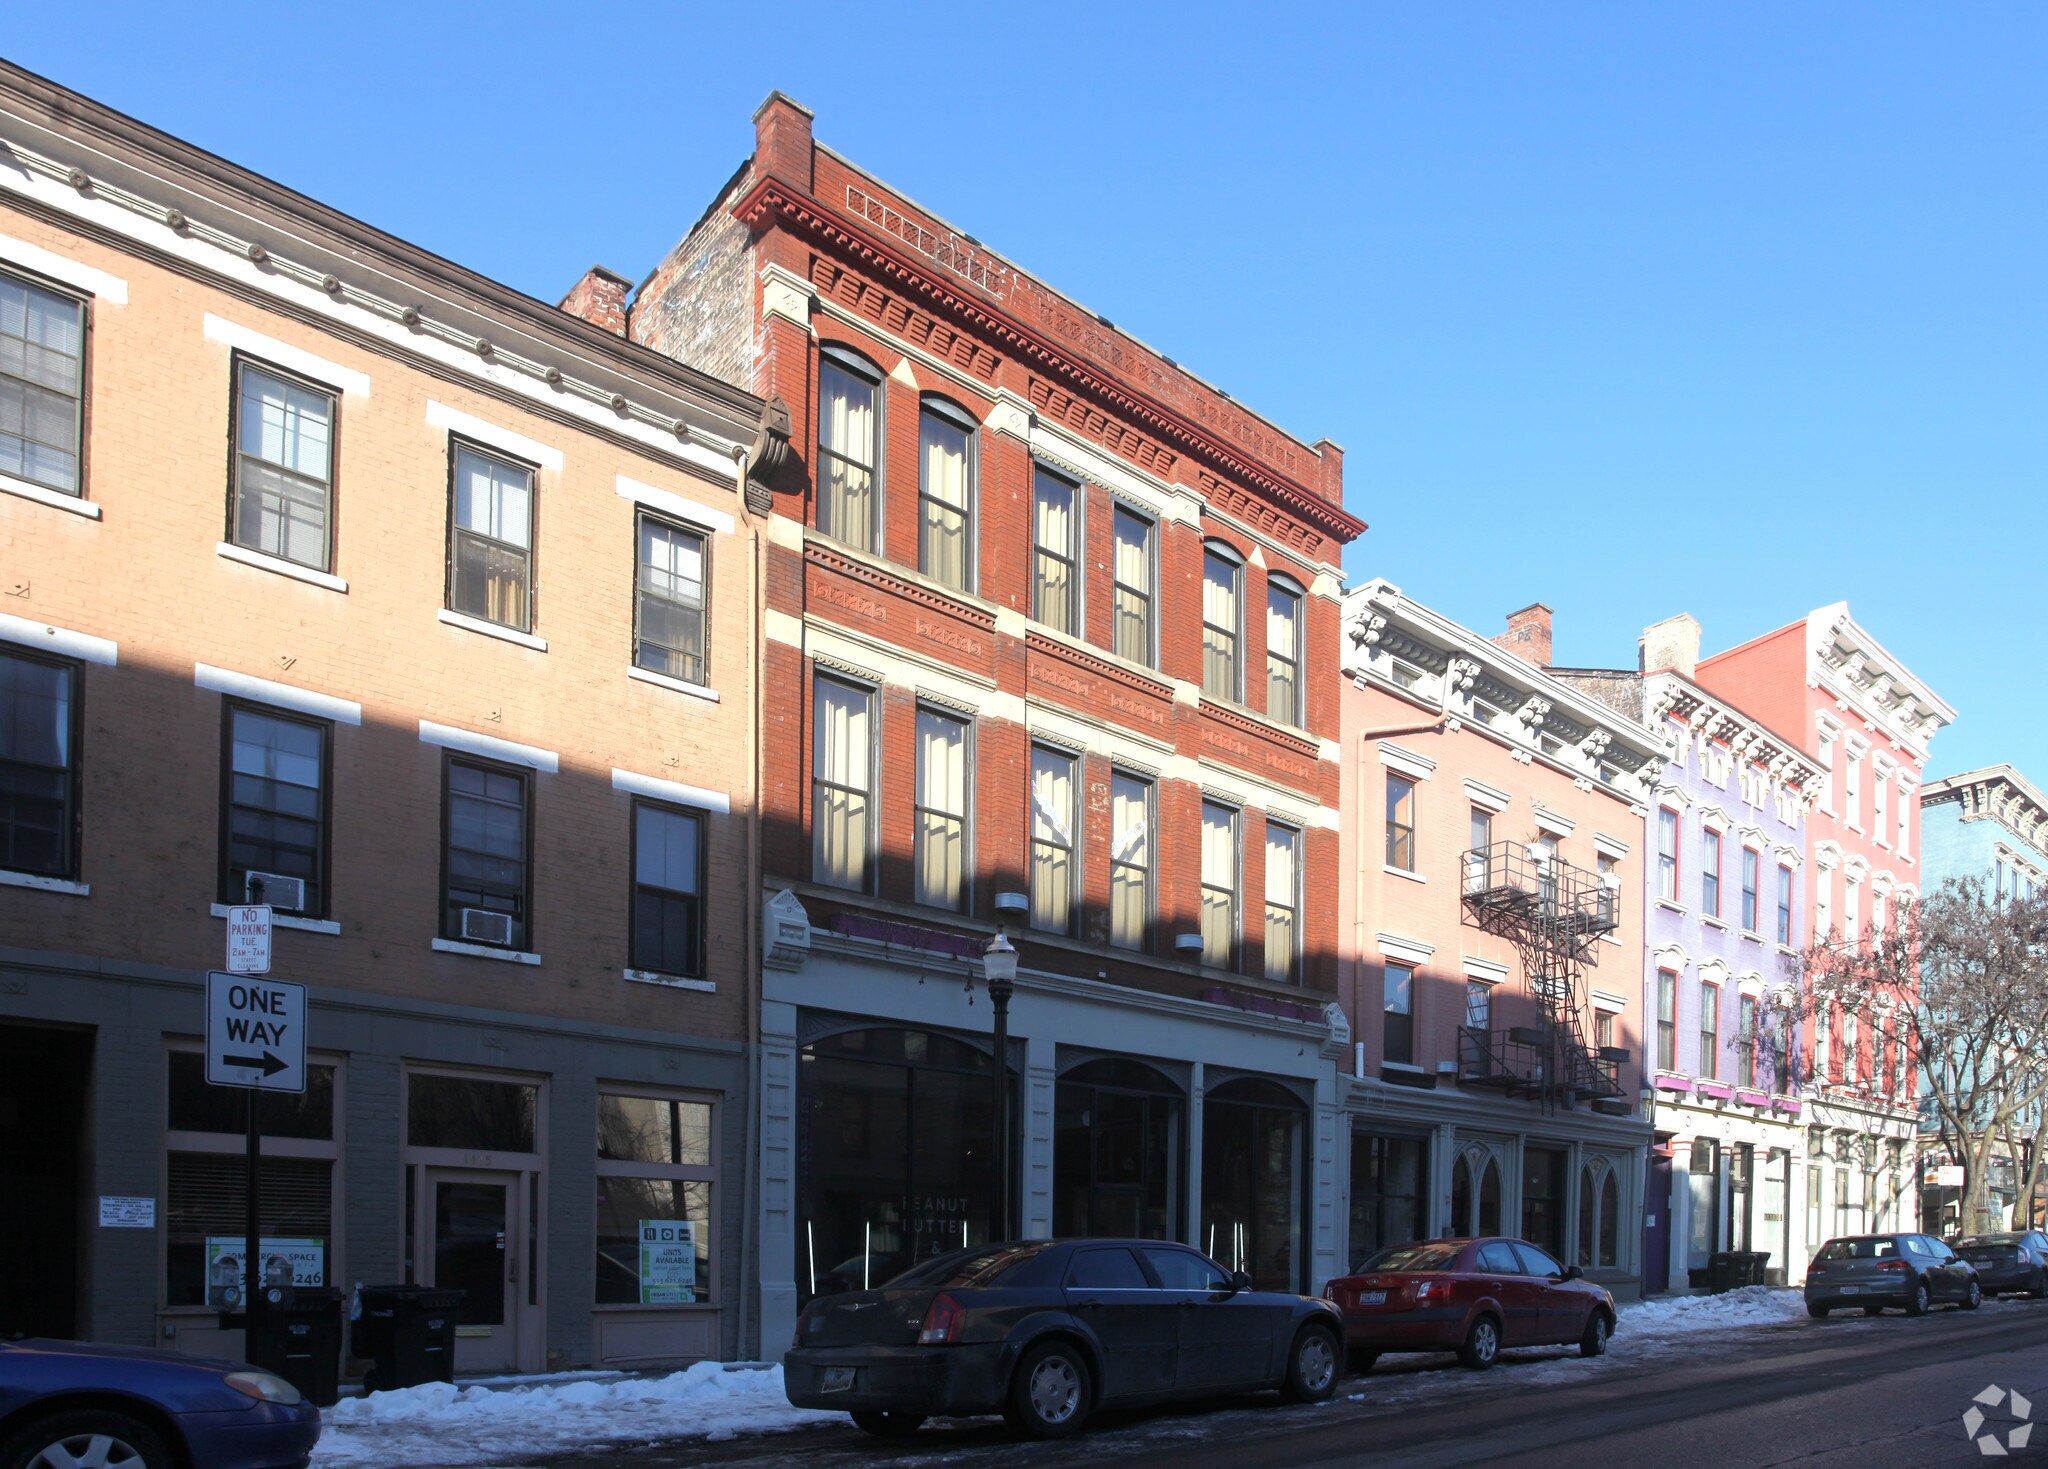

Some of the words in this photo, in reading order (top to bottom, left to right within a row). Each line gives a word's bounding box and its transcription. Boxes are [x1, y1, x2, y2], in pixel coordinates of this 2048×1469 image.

[241, 910, 258, 923] NO
[231, 924, 267, 936] PARKING
[241, 937, 258, 946] TUE.
[228, 985, 287, 1016] ONE
[226, 1017, 288, 1047] WAY
[663, 1248, 682, 1256] UNITS
[931, 1240, 940, 1254] &
[289, 1253, 316, 1261] SPACE
